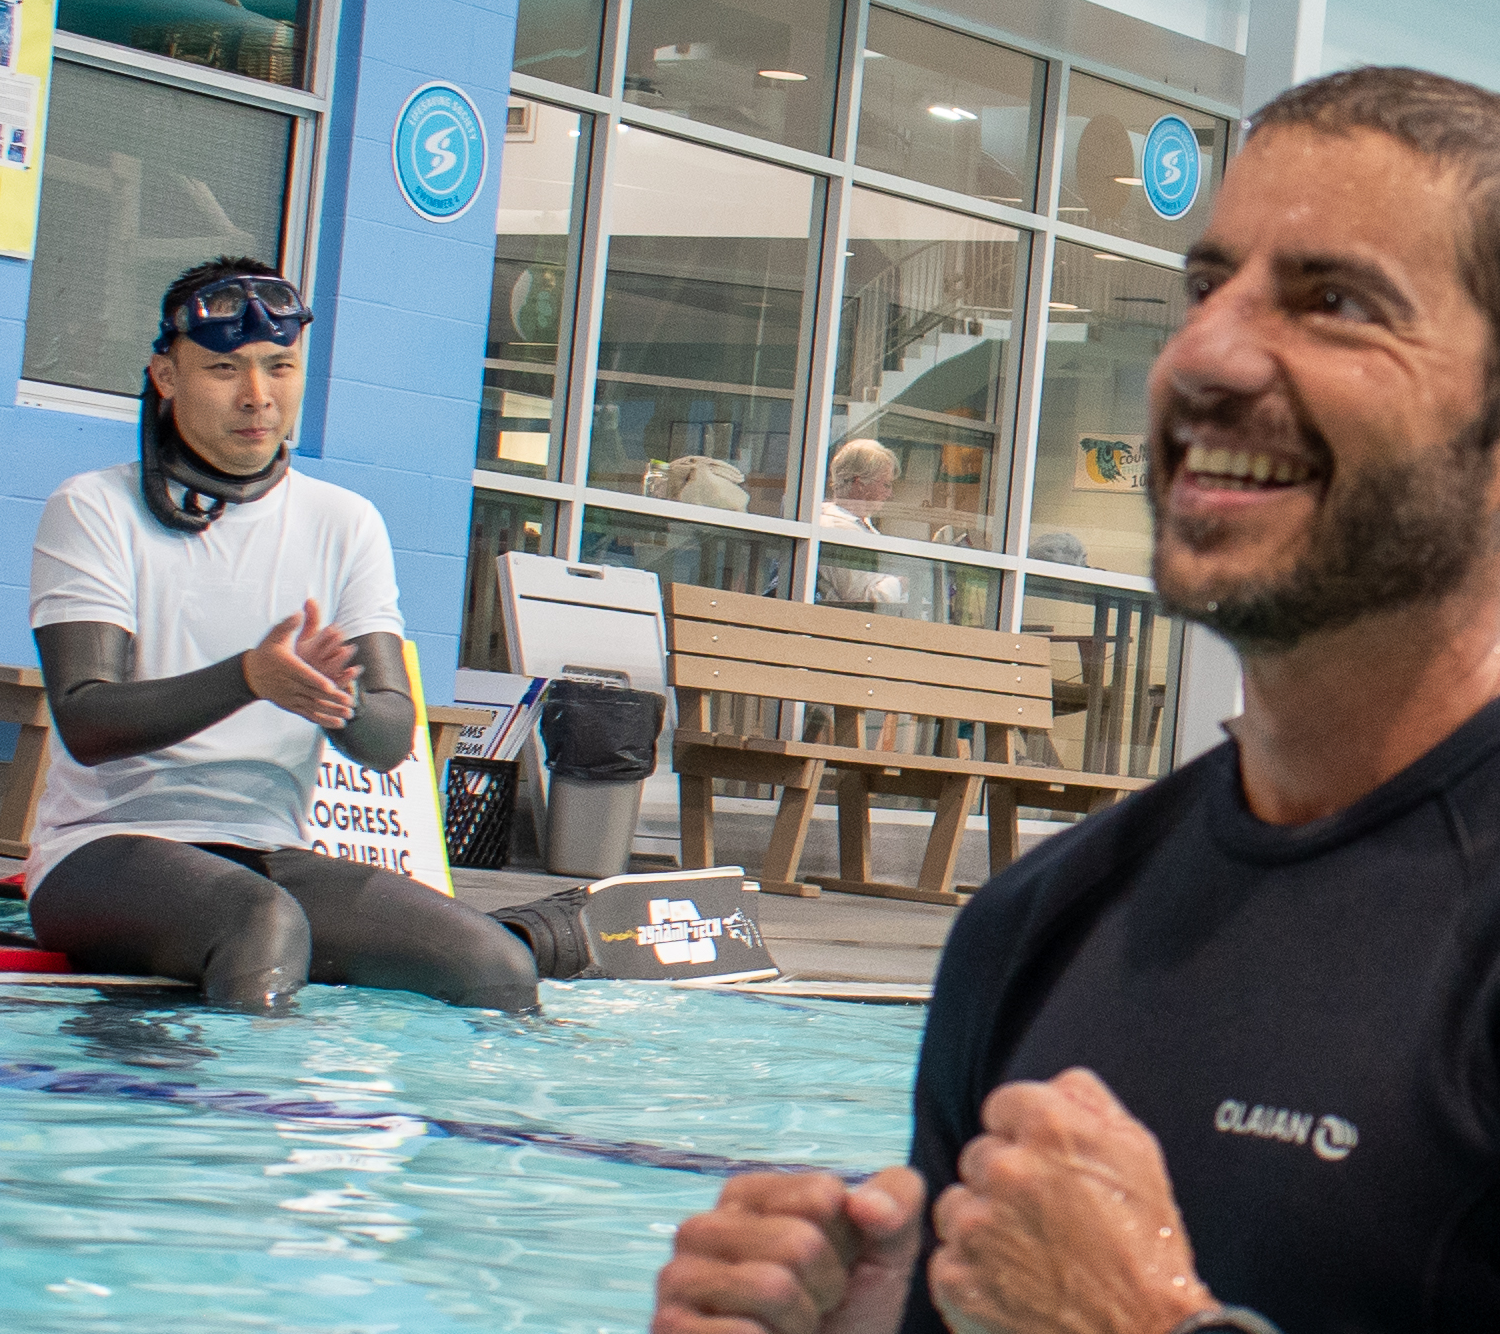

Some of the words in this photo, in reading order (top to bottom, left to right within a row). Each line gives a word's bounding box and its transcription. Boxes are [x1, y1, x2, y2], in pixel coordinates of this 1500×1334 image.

[316, 761, 373, 794] TALS
[379, 771, 405, 798] IN
[308, 799, 409, 838] OGRESS.
